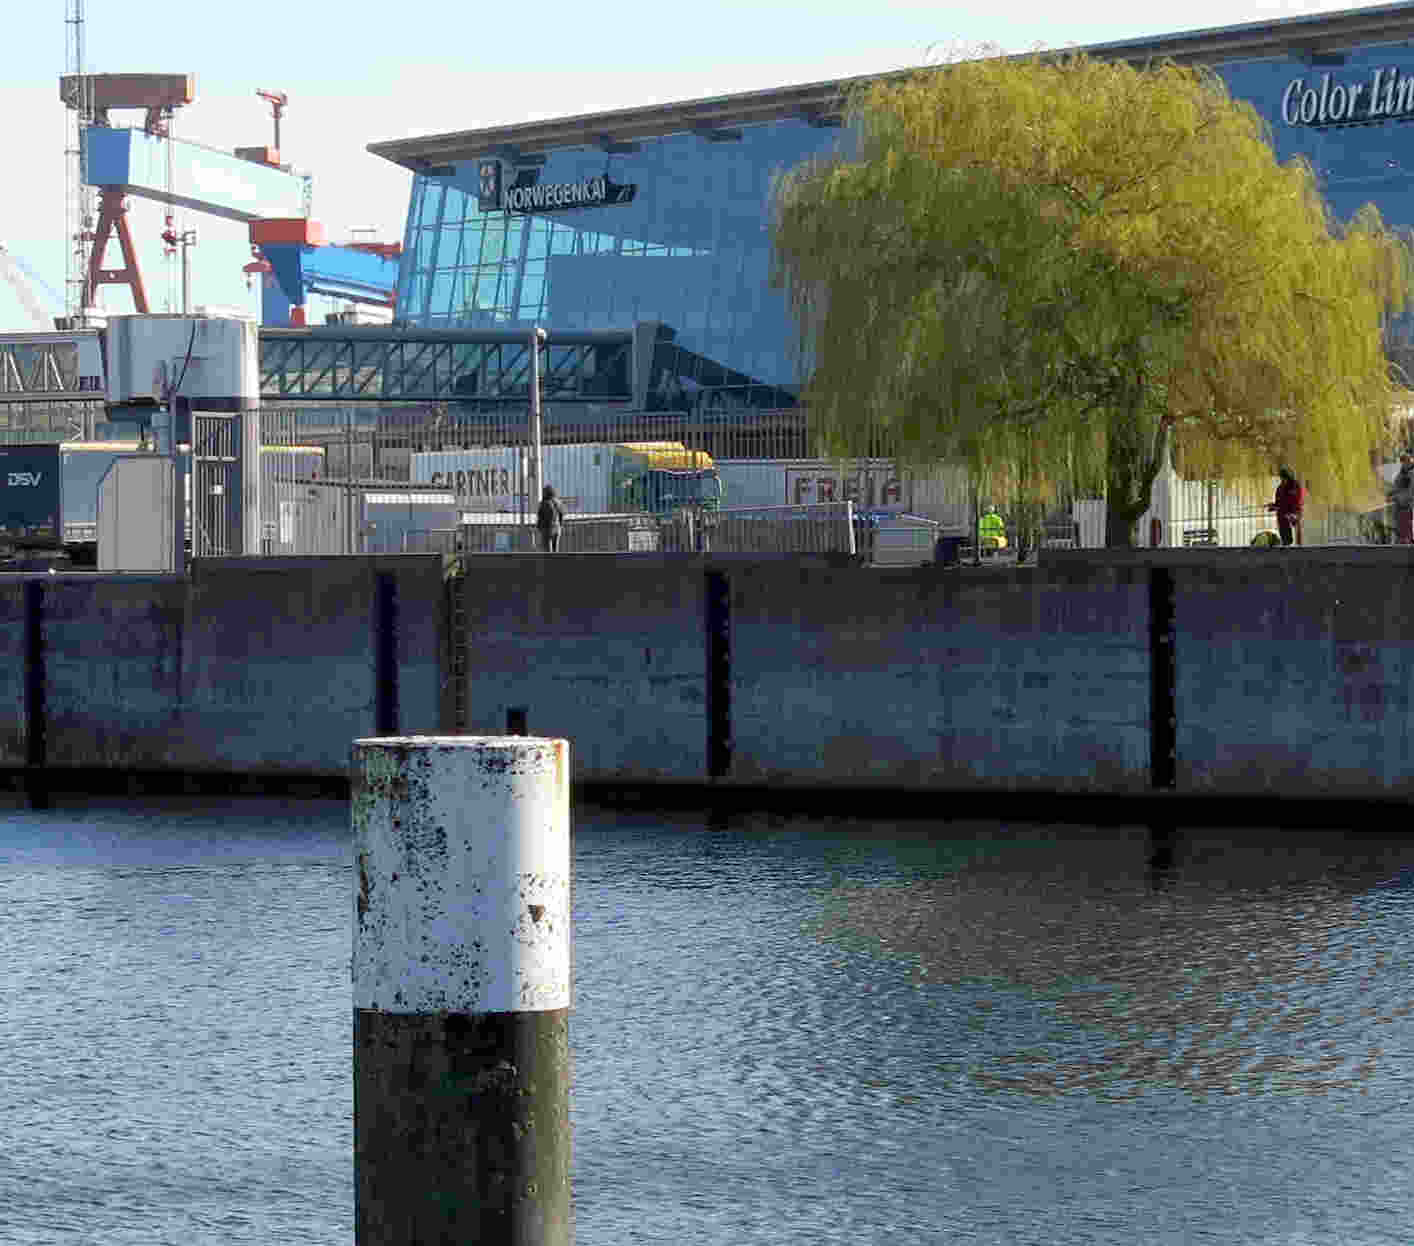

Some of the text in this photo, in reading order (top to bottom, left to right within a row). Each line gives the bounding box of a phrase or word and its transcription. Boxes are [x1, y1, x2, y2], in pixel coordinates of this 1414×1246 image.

[1282, 73, 1364, 127] Color
[503, 177, 607, 209] NORWEGENKAI
[7, 472, 42, 488] DSV
